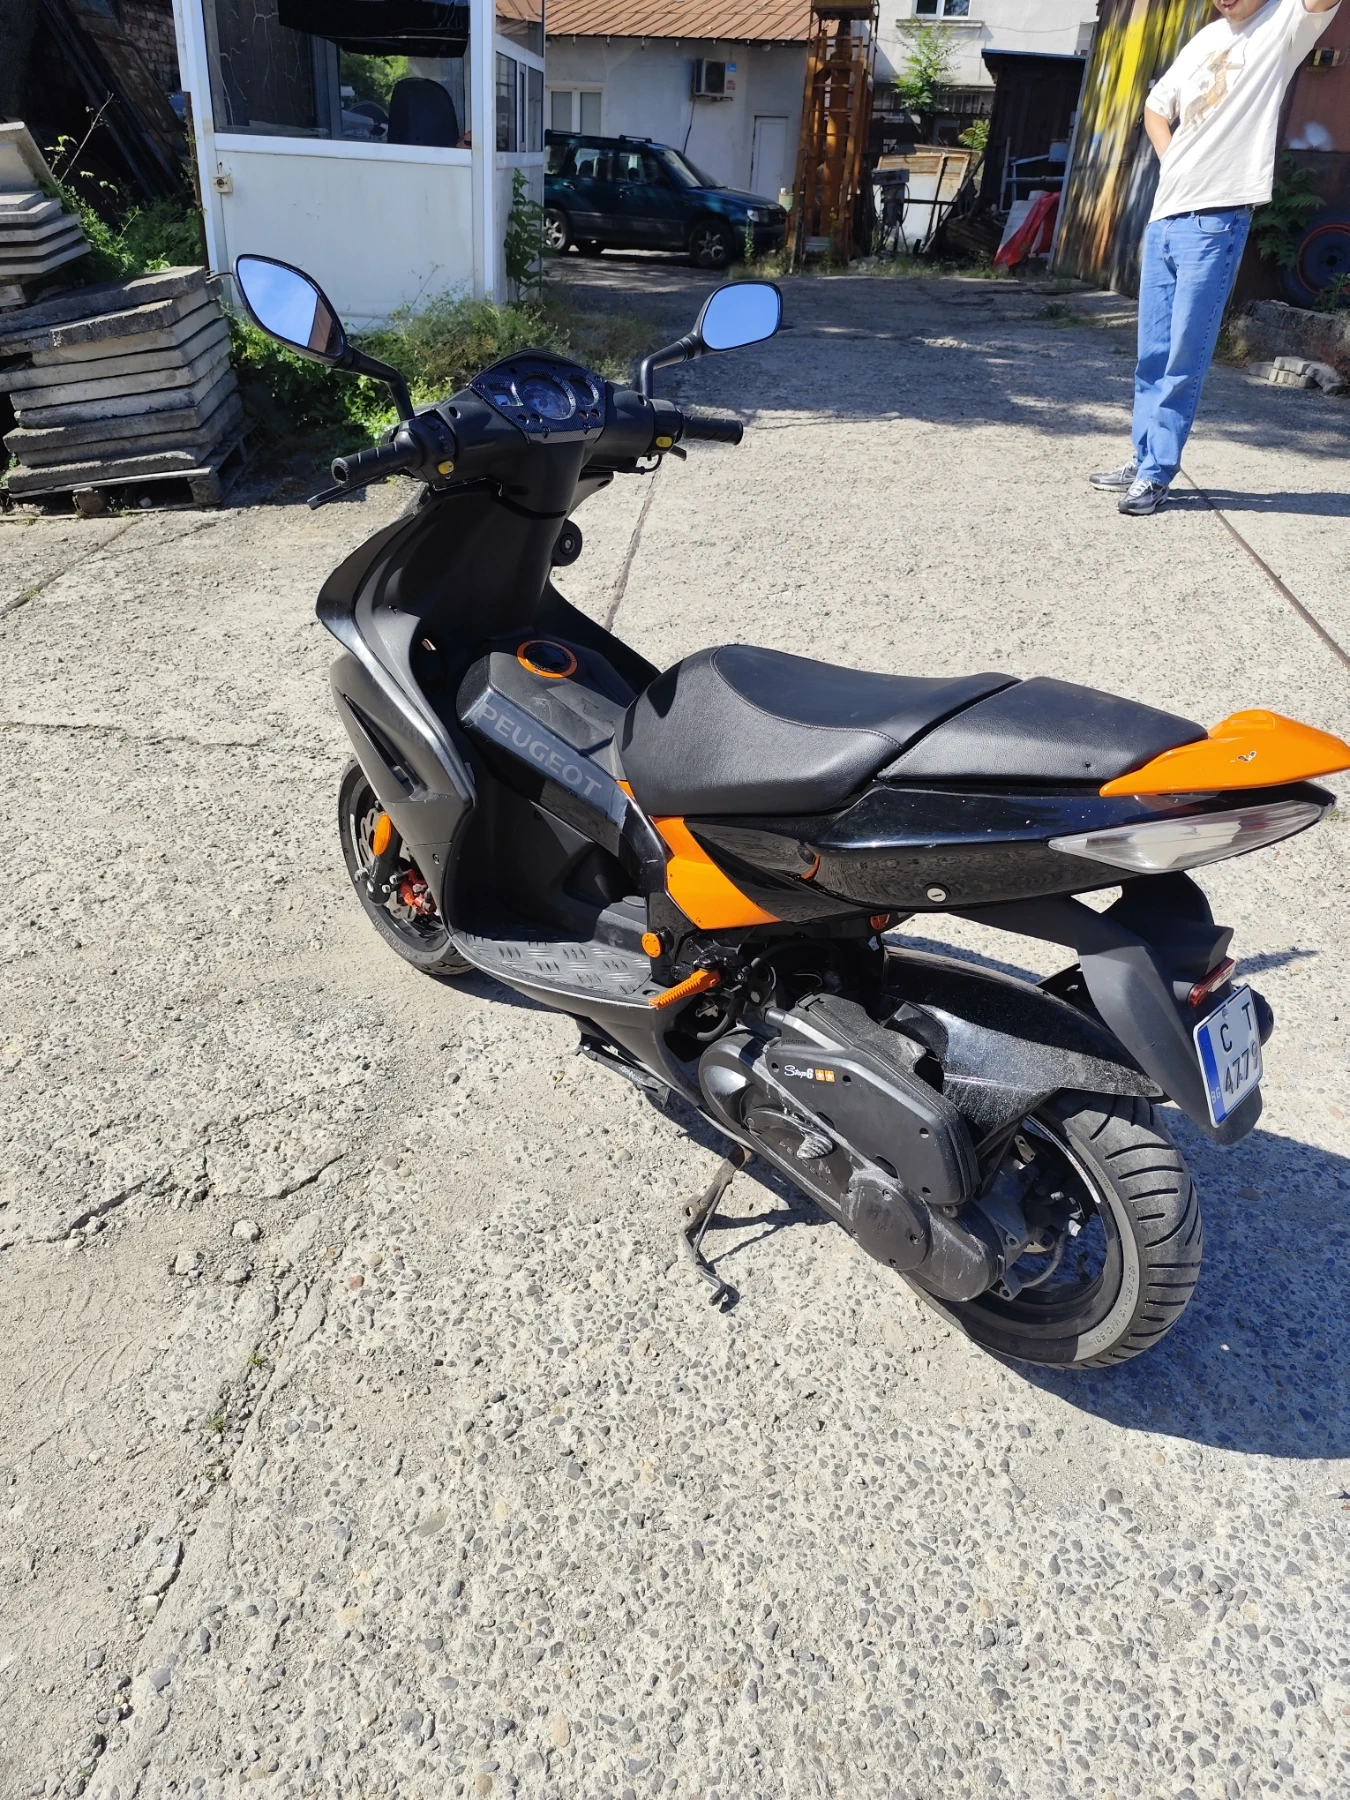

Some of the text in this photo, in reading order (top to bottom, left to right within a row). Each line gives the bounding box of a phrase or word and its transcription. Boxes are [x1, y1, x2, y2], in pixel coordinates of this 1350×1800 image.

[480, 702, 603, 797] PEUGEOT
[1219, 1004, 1253, 1053] C T
[1224, 1041, 1259, 1095] 4779
[1211, 1086, 1221, 1104] BG
